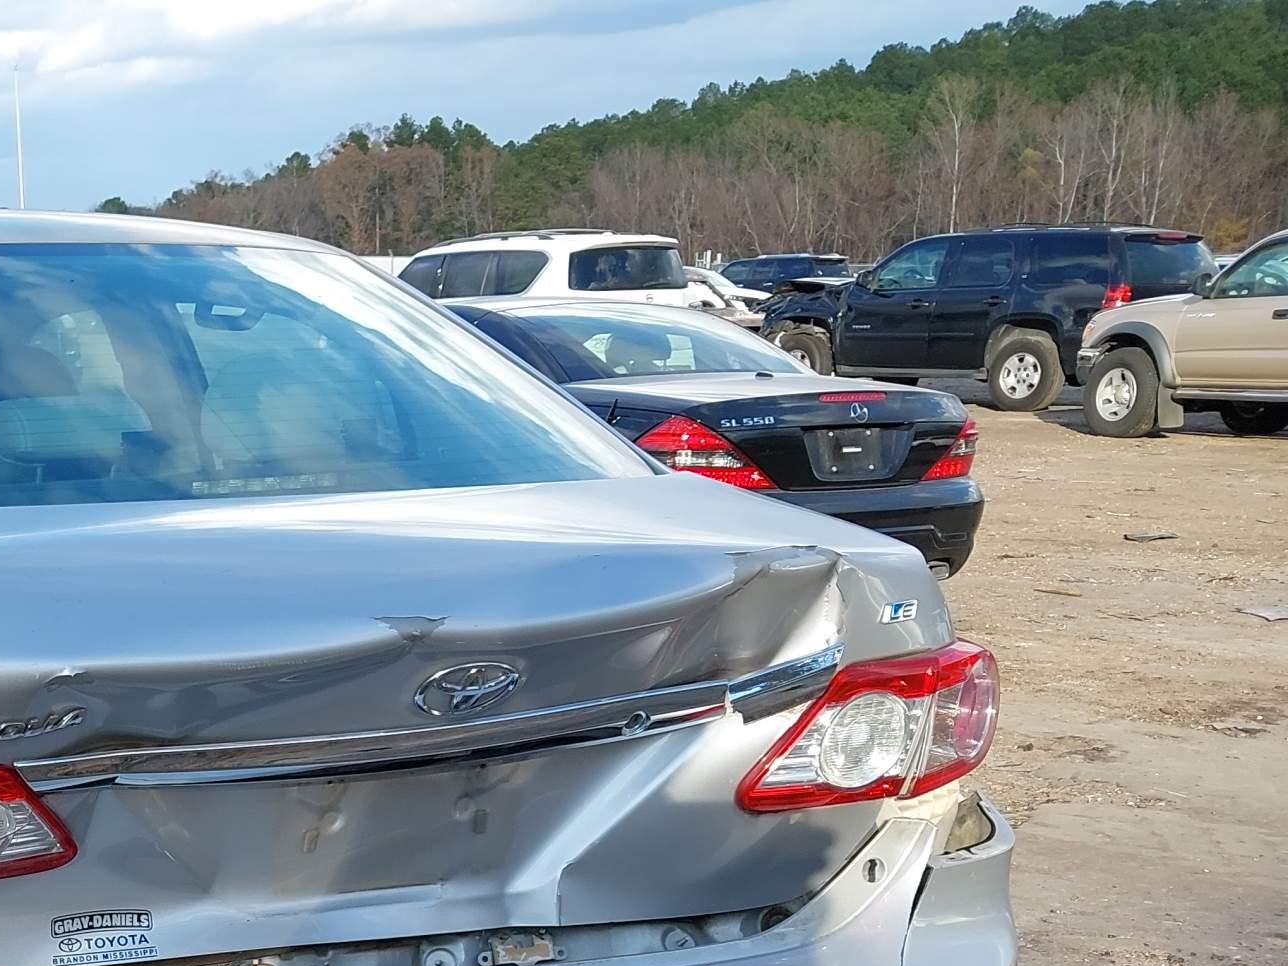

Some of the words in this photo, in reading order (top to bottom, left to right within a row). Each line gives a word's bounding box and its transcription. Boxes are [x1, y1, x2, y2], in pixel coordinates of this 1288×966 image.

[879, 599, 918, 624] LE
[84, 934, 150, 949] TOYOTA
[52, 954, 99, 965] BRANDON
[102, 949, 158, 960] MISSISSIPPI
